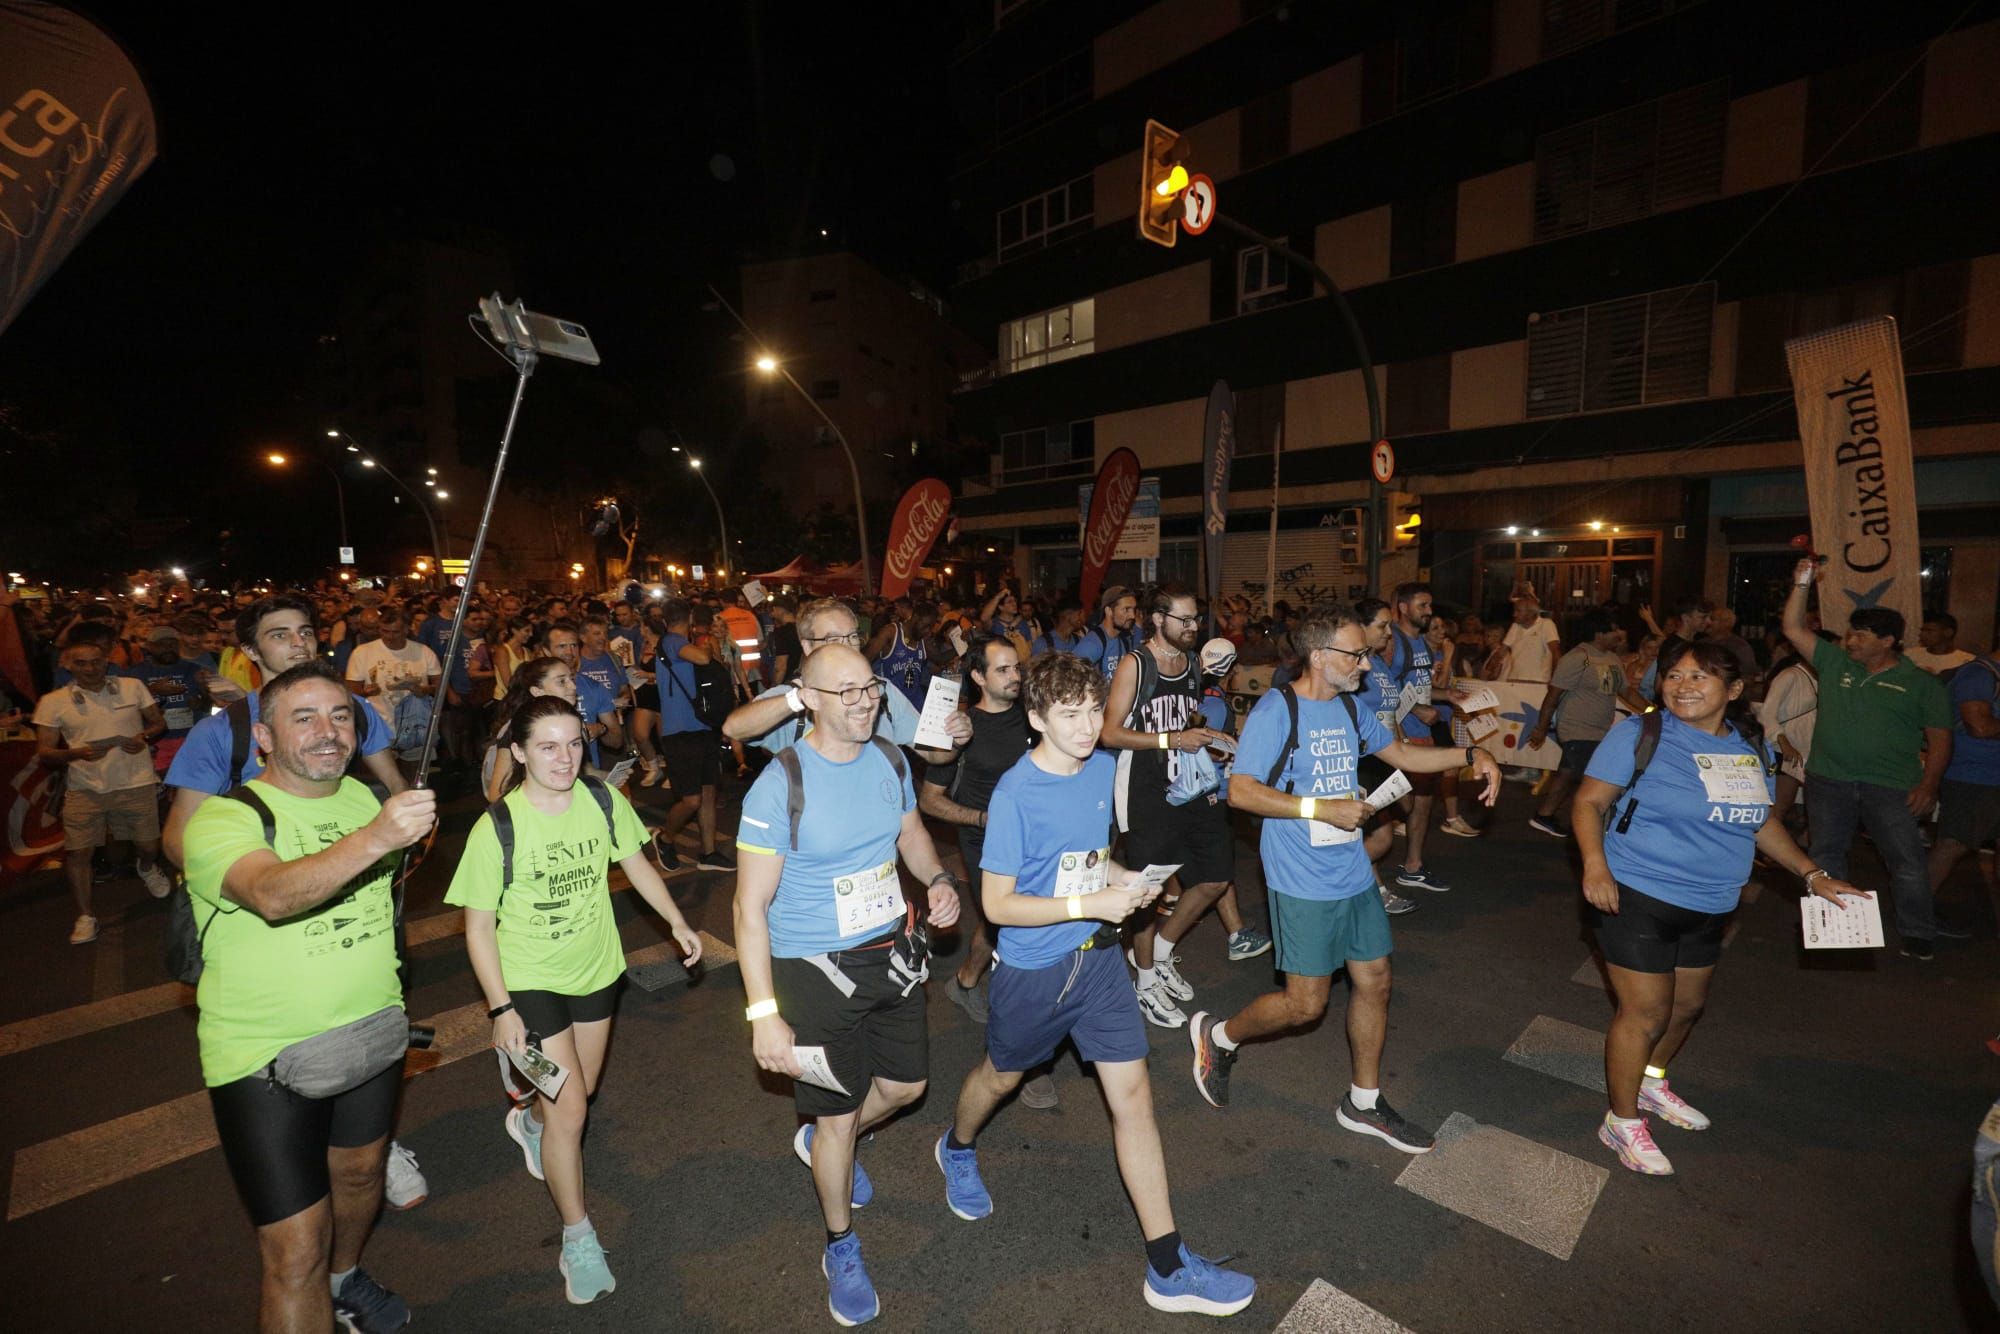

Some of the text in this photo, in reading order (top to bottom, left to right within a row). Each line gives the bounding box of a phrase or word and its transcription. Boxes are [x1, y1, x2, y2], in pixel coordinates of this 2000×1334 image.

[1826, 369, 1892, 573] CaixaBank
[887, 487, 944, 579] Coca-Cola
[1310, 738, 1351, 757] GÜELL
[1312, 756, 1354, 775] A LLUC
[1311, 775, 1350, 793] A PEU
[1707, 806, 1764, 823] A PEU
[547, 838, 600, 868] SNIP
[549, 865, 595, 888] MARINA
